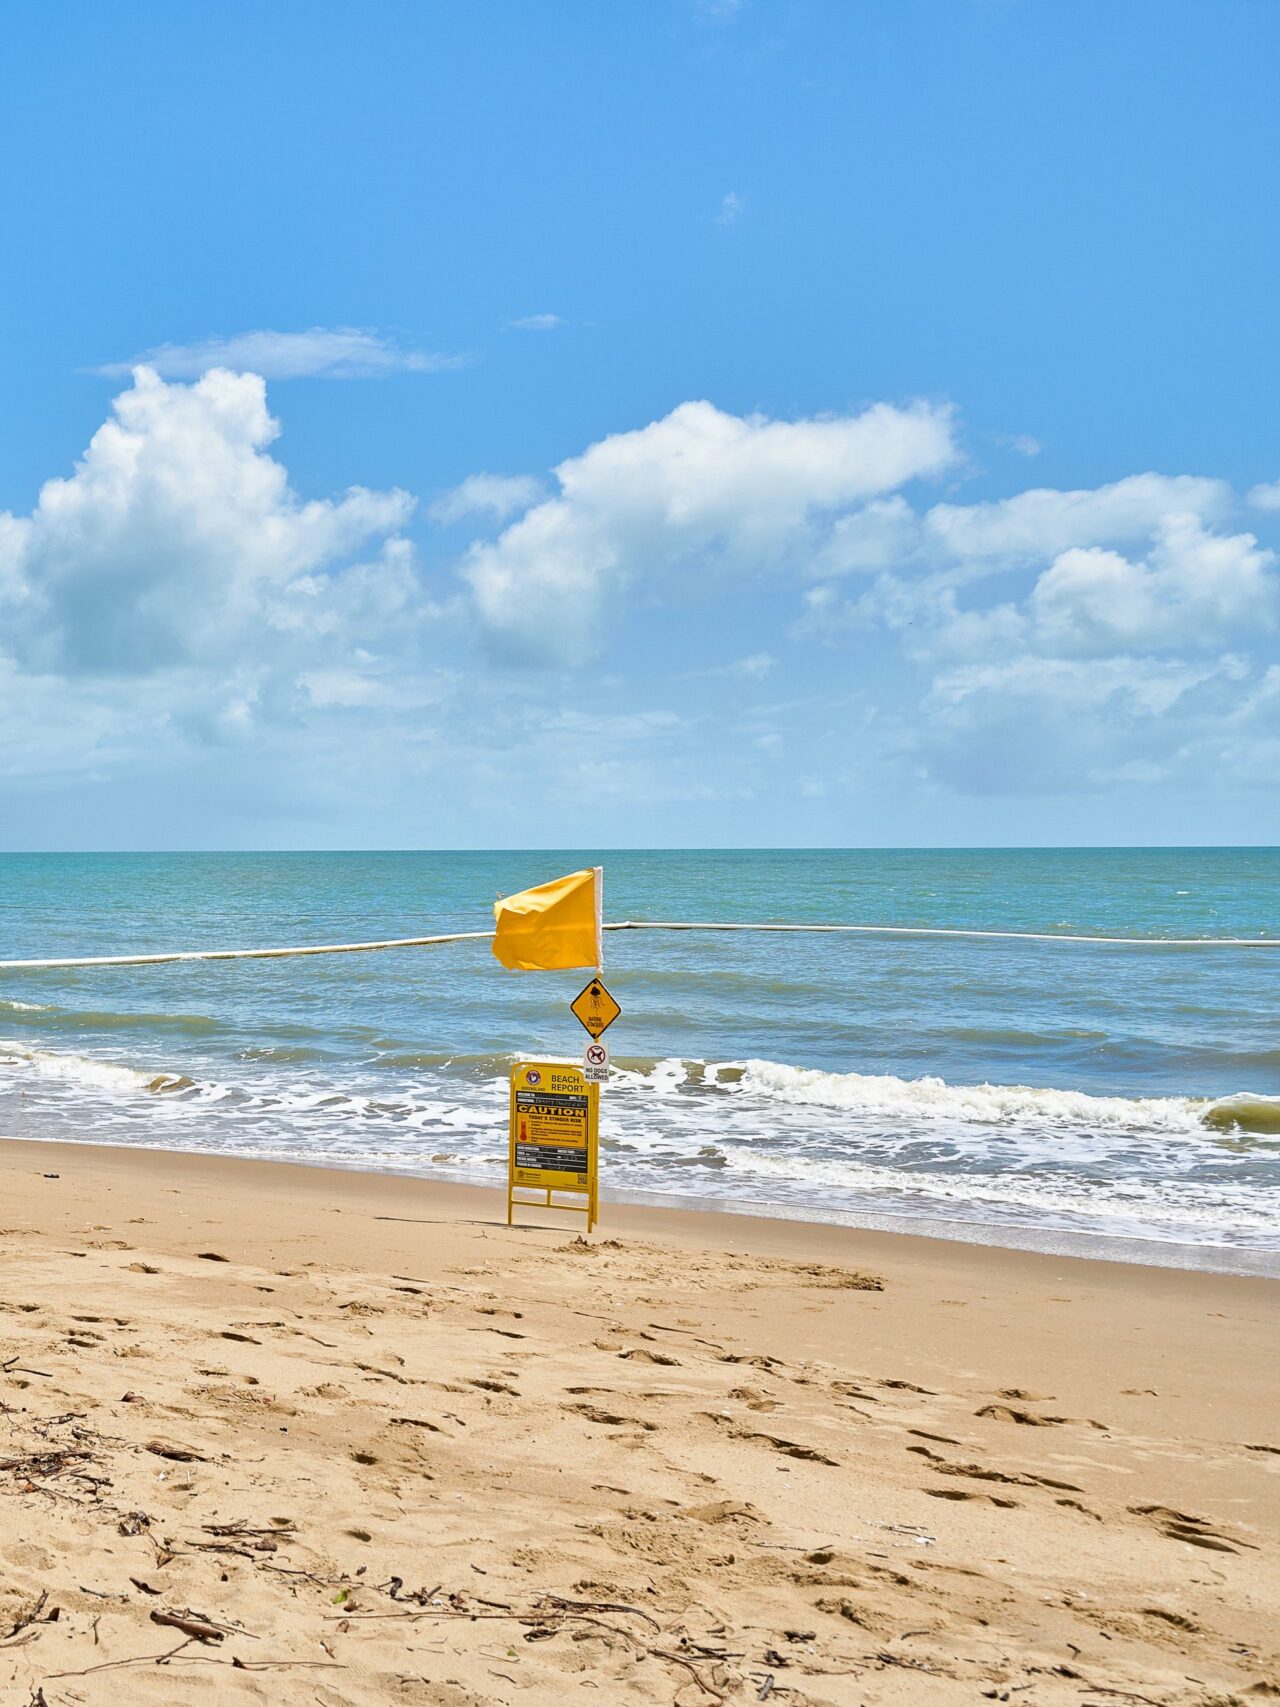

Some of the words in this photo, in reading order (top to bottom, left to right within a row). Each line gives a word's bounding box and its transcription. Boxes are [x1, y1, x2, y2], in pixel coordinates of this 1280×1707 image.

[551, 1075, 580, 1083] BEACH
[551, 1084, 584, 1093] REPORT
[518, 1105, 585, 1117] CAUTION
